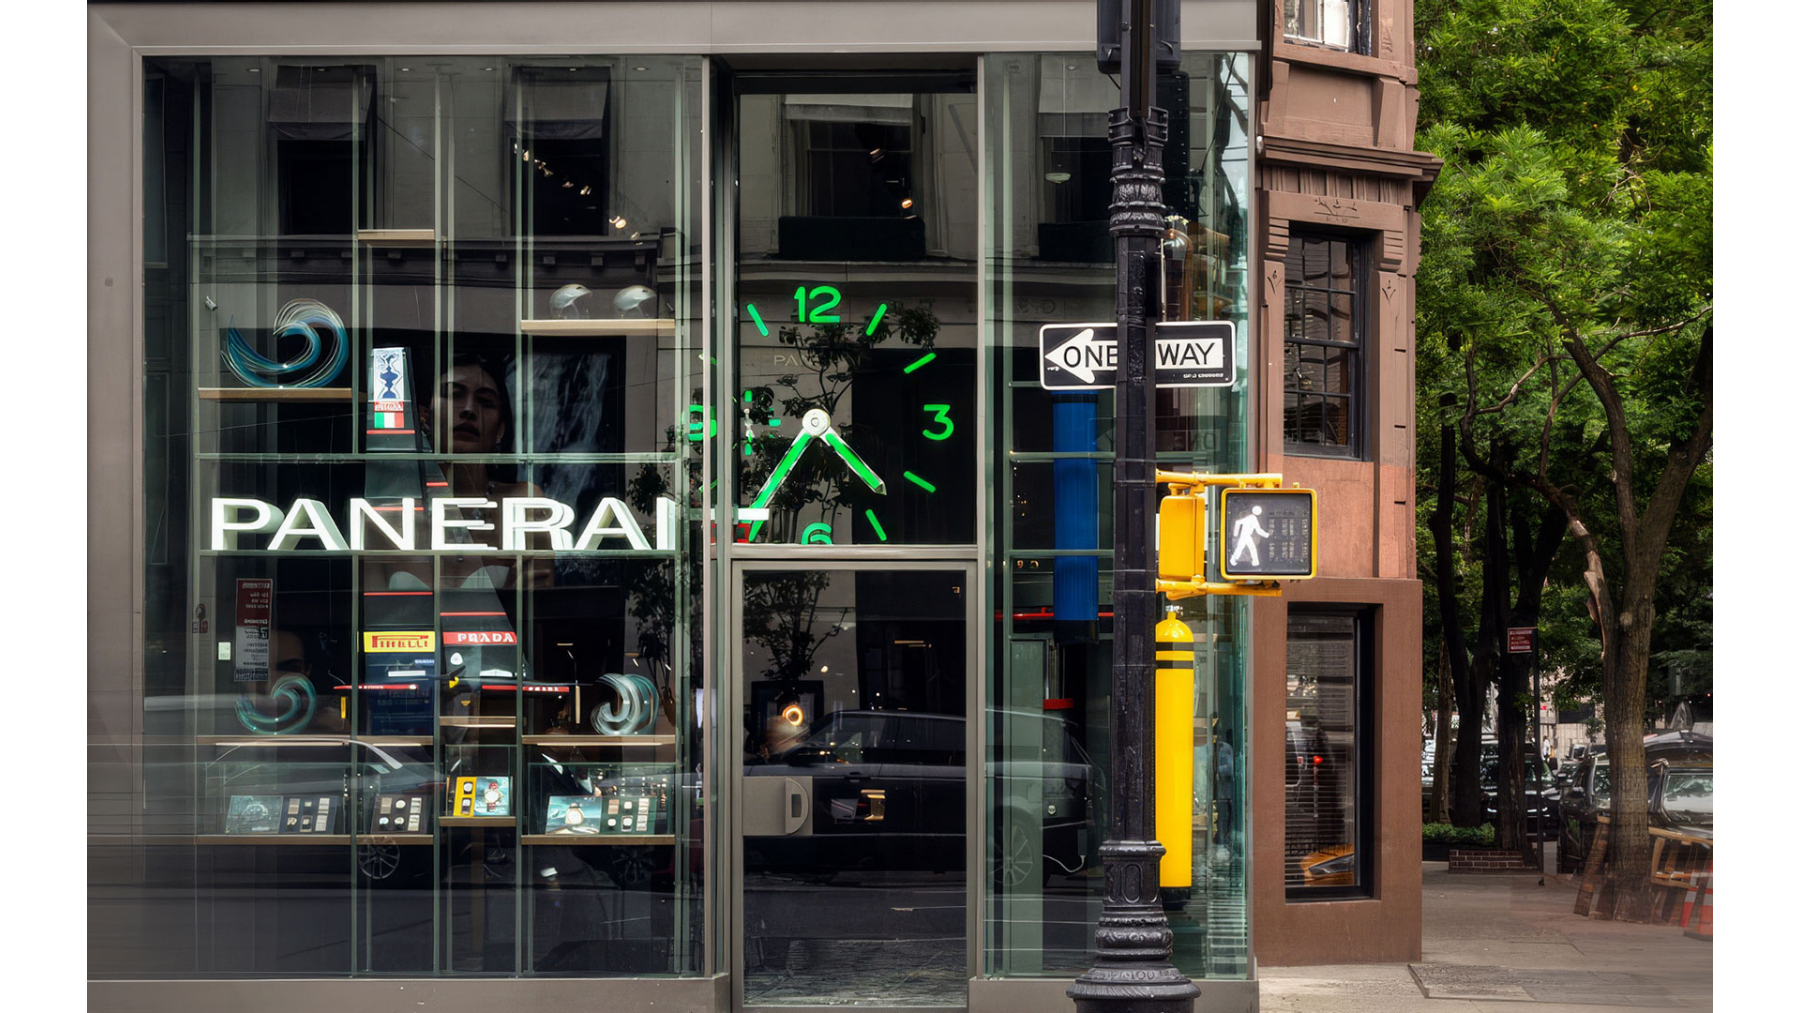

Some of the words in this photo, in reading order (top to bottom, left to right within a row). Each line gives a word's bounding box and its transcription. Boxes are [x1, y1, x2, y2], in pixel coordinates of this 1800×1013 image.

[793, 285, 842, 324] 12
[1063, 345, 1118, 368] ONE
[1157, 342, 1216, 366] WAY
[922, 403, 955, 441] 3
[211, 497, 676, 551] PANERAI
[371, 635, 429, 648] PIRELLI
[457, 632, 514, 643] PRADA
